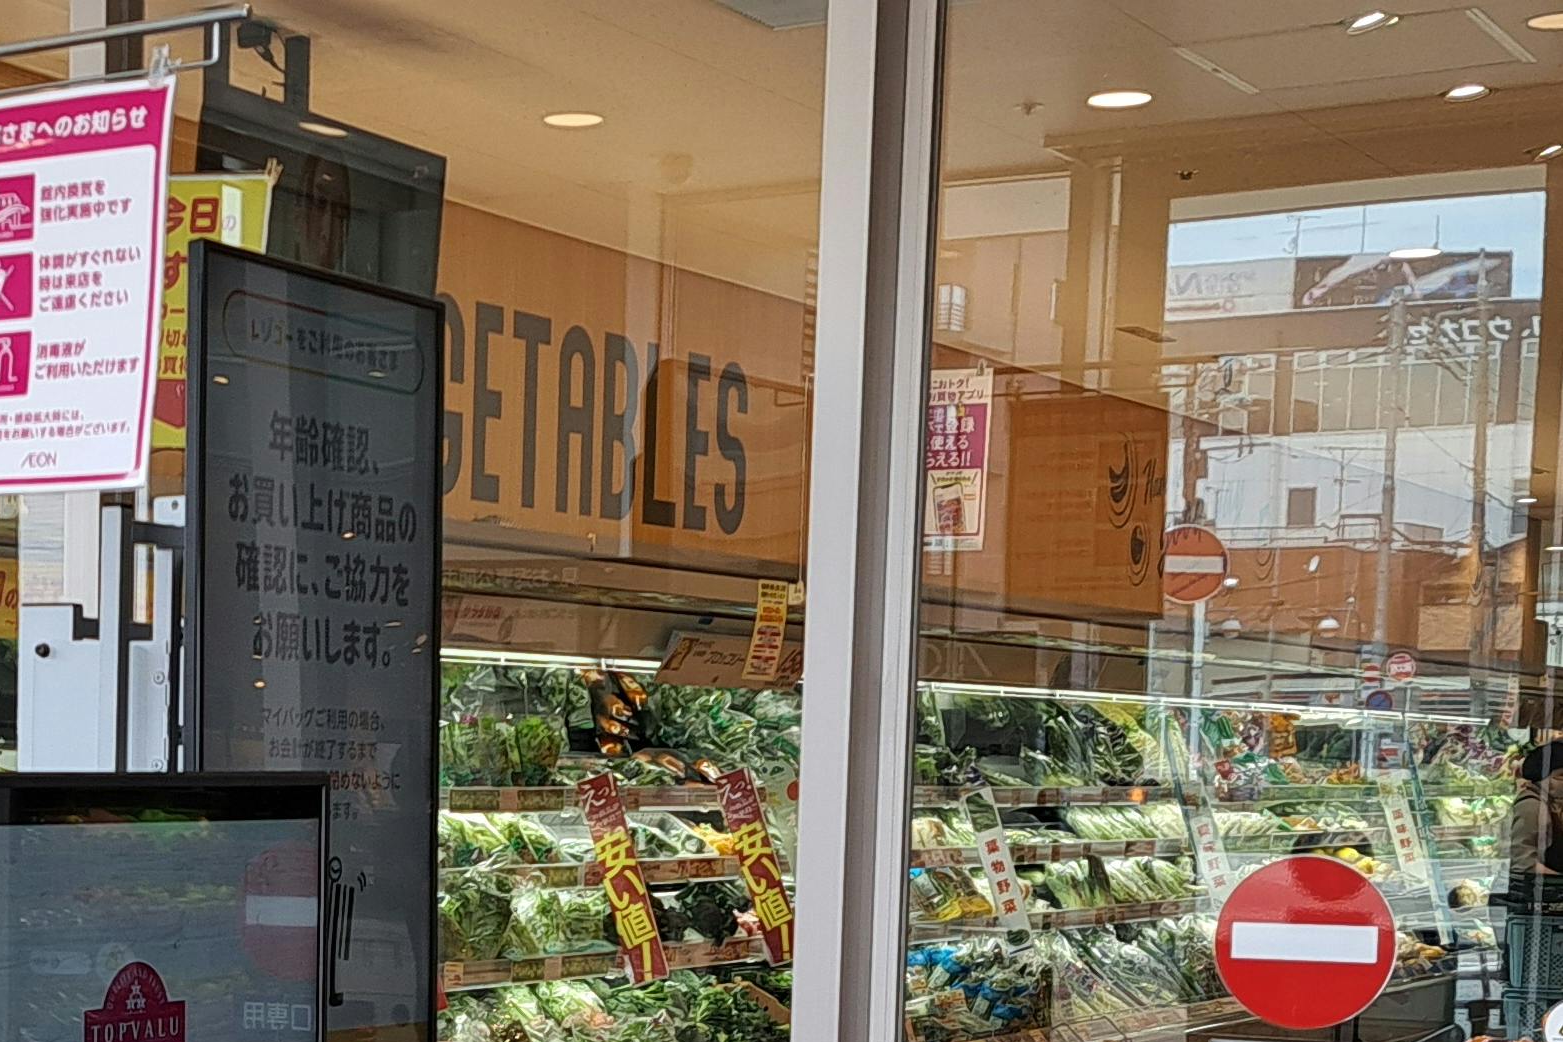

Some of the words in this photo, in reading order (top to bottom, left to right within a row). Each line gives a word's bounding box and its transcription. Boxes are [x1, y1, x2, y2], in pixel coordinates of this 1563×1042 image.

[40, 197, 132, 223] 強化実施中です
[39, 245, 141, 271] 体調がすぐれない
[38, 270, 103, 292] 時は来店を
[39, 288, 129, 312] ご遠慮ください
[36, 338, 86, 359] 消毒液が
[34, 356, 140, 380] ご利用いただけます
[269, 410, 379, 475] 年齢確認、
[228, 473, 417, 543] お買い上げ商品の
[235, 541, 410, 607] 確認に、ご協力を
[252, 611, 390, 668] お願いします。
[263, 706, 385, 732] マイバッグご利用の場合、
